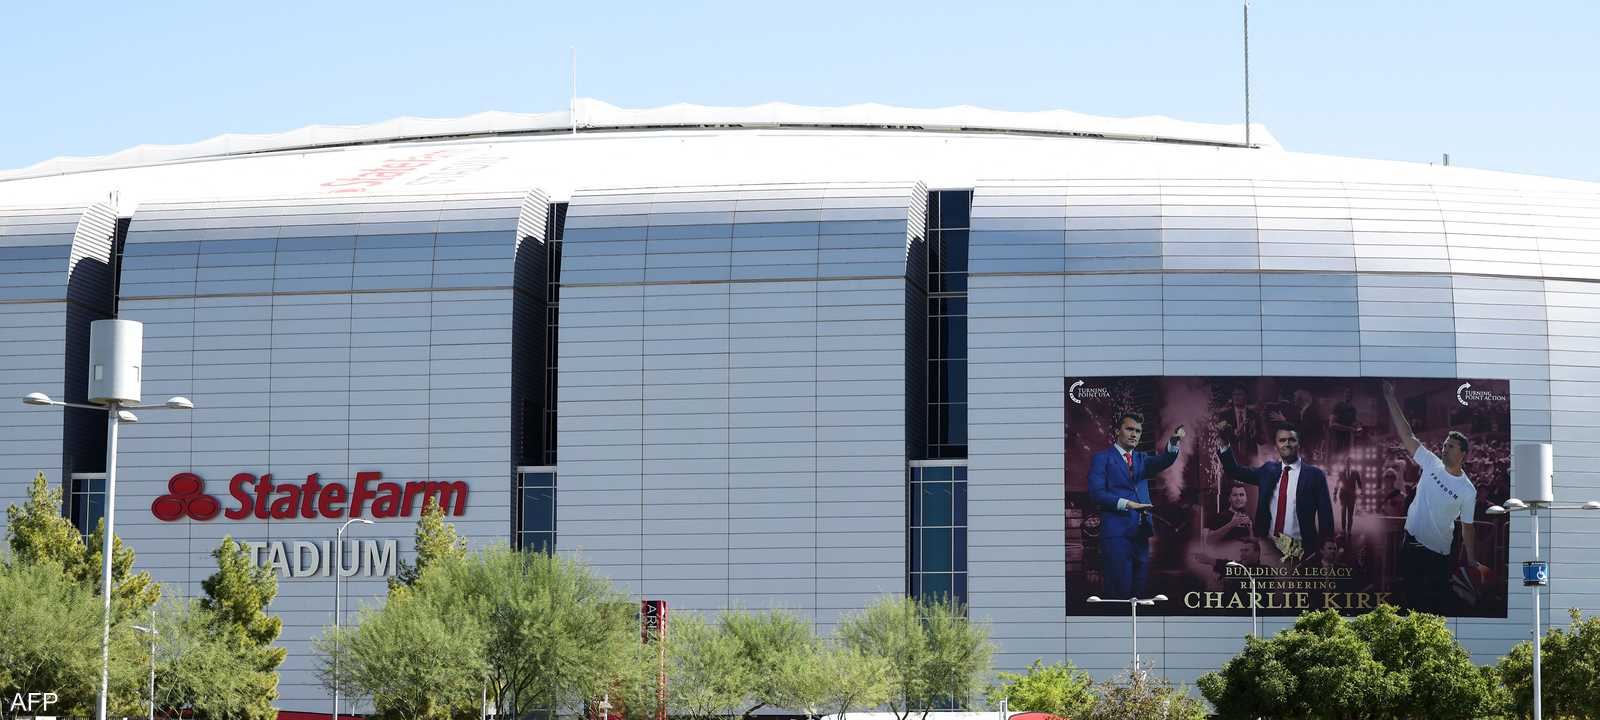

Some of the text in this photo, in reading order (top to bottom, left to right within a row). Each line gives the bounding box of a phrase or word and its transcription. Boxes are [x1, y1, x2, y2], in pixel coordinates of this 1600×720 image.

[1430, 472, 1459, 500] FREEDOM
[230, 539, 399, 577] TADIUM
[1225, 567, 1353, 577] BUILDING A LEGACY
[1183, 591, 1393, 609] CHARLIE KIRK
